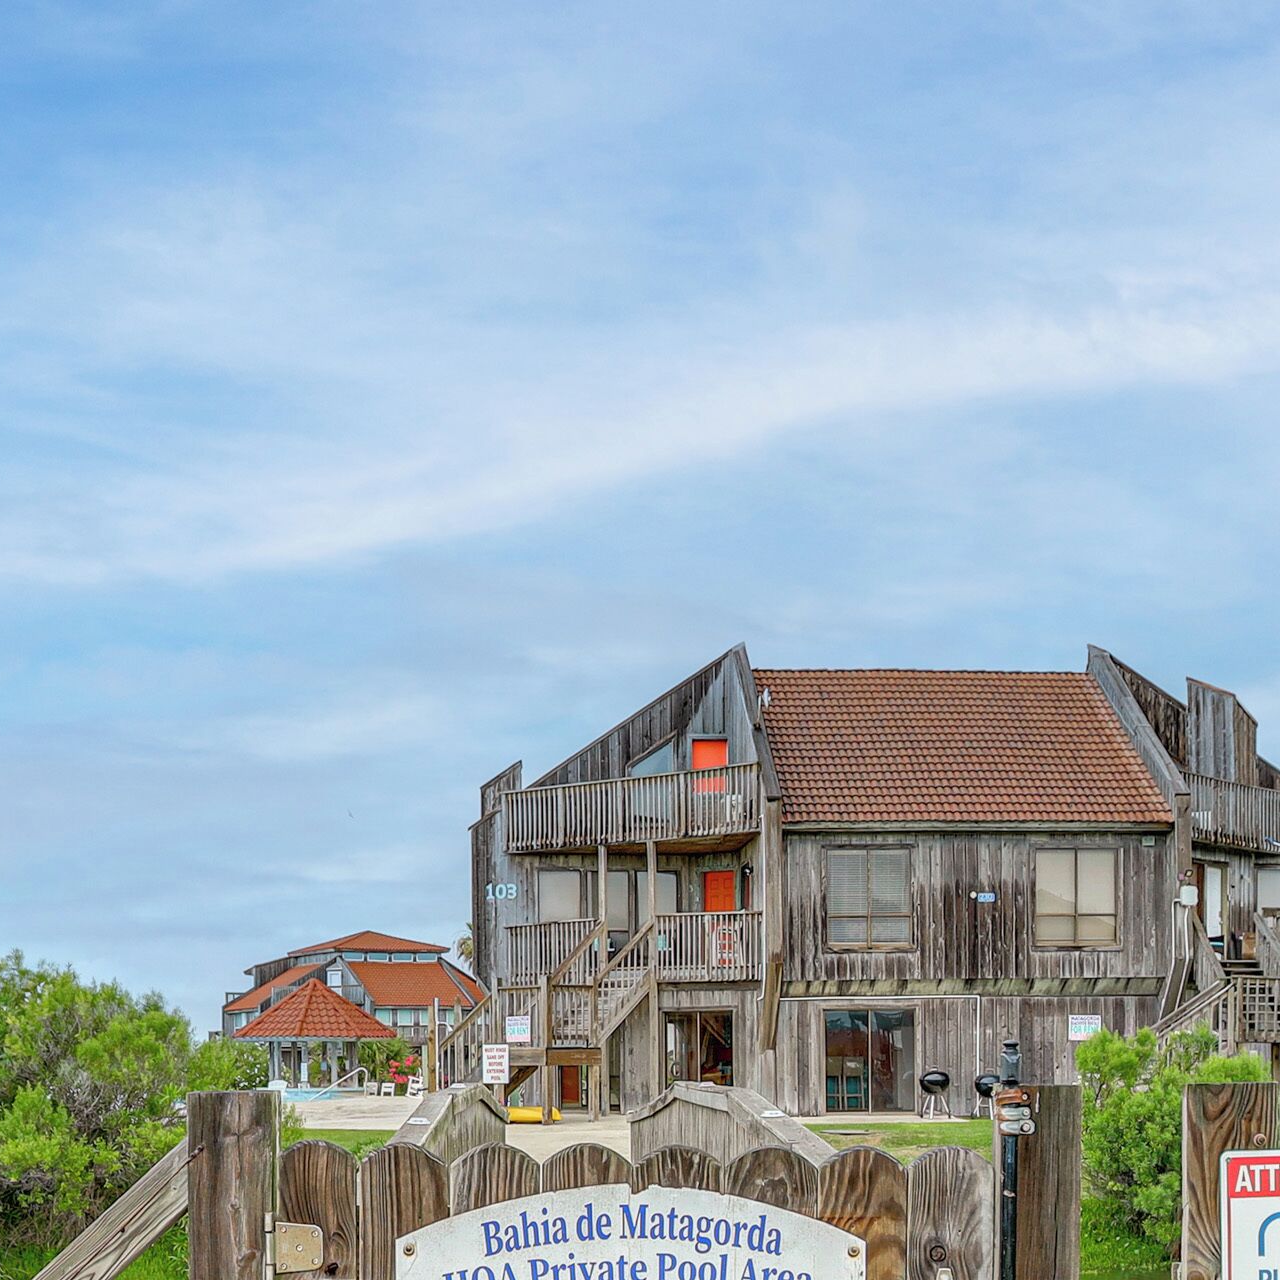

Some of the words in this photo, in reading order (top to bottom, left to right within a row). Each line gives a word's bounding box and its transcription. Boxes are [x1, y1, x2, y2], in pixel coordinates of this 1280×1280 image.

[485, 883, 517, 900] 103
[481, 1208, 569, 1257] Bahia
[576, 1203, 611, 1241] de
[619, 1204, 781, 1256] Matagorda
